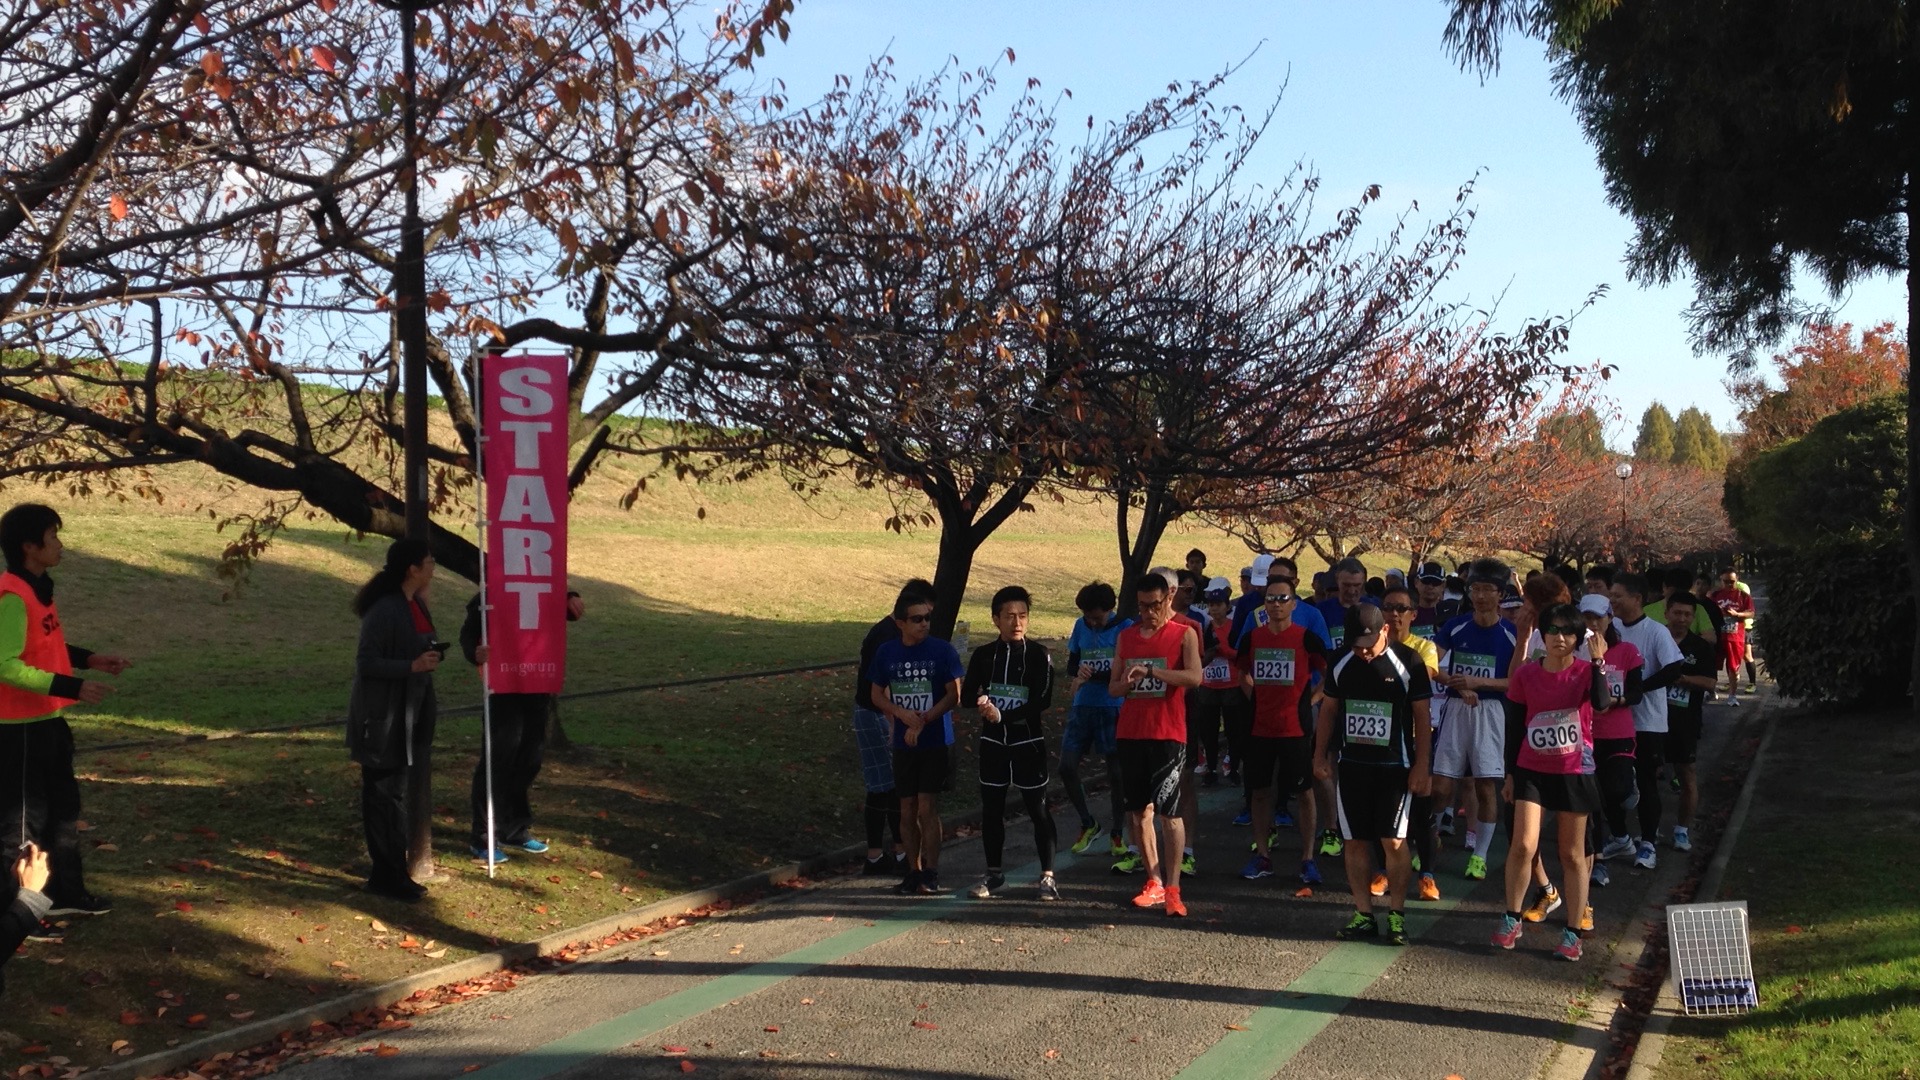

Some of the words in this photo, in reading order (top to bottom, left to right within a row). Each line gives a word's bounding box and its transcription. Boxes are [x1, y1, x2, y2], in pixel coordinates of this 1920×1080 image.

[499, 367, 555, 629] START
[500, 662, 556, 677] nagorun
[1205, 666, 1228, 679] G307
[1256, 661, 1290, 679] B231
[895, 694, 929, 711] B207
[1347, 715, 1387, 738] B233
[1531, 724, 1579, 748] G306
